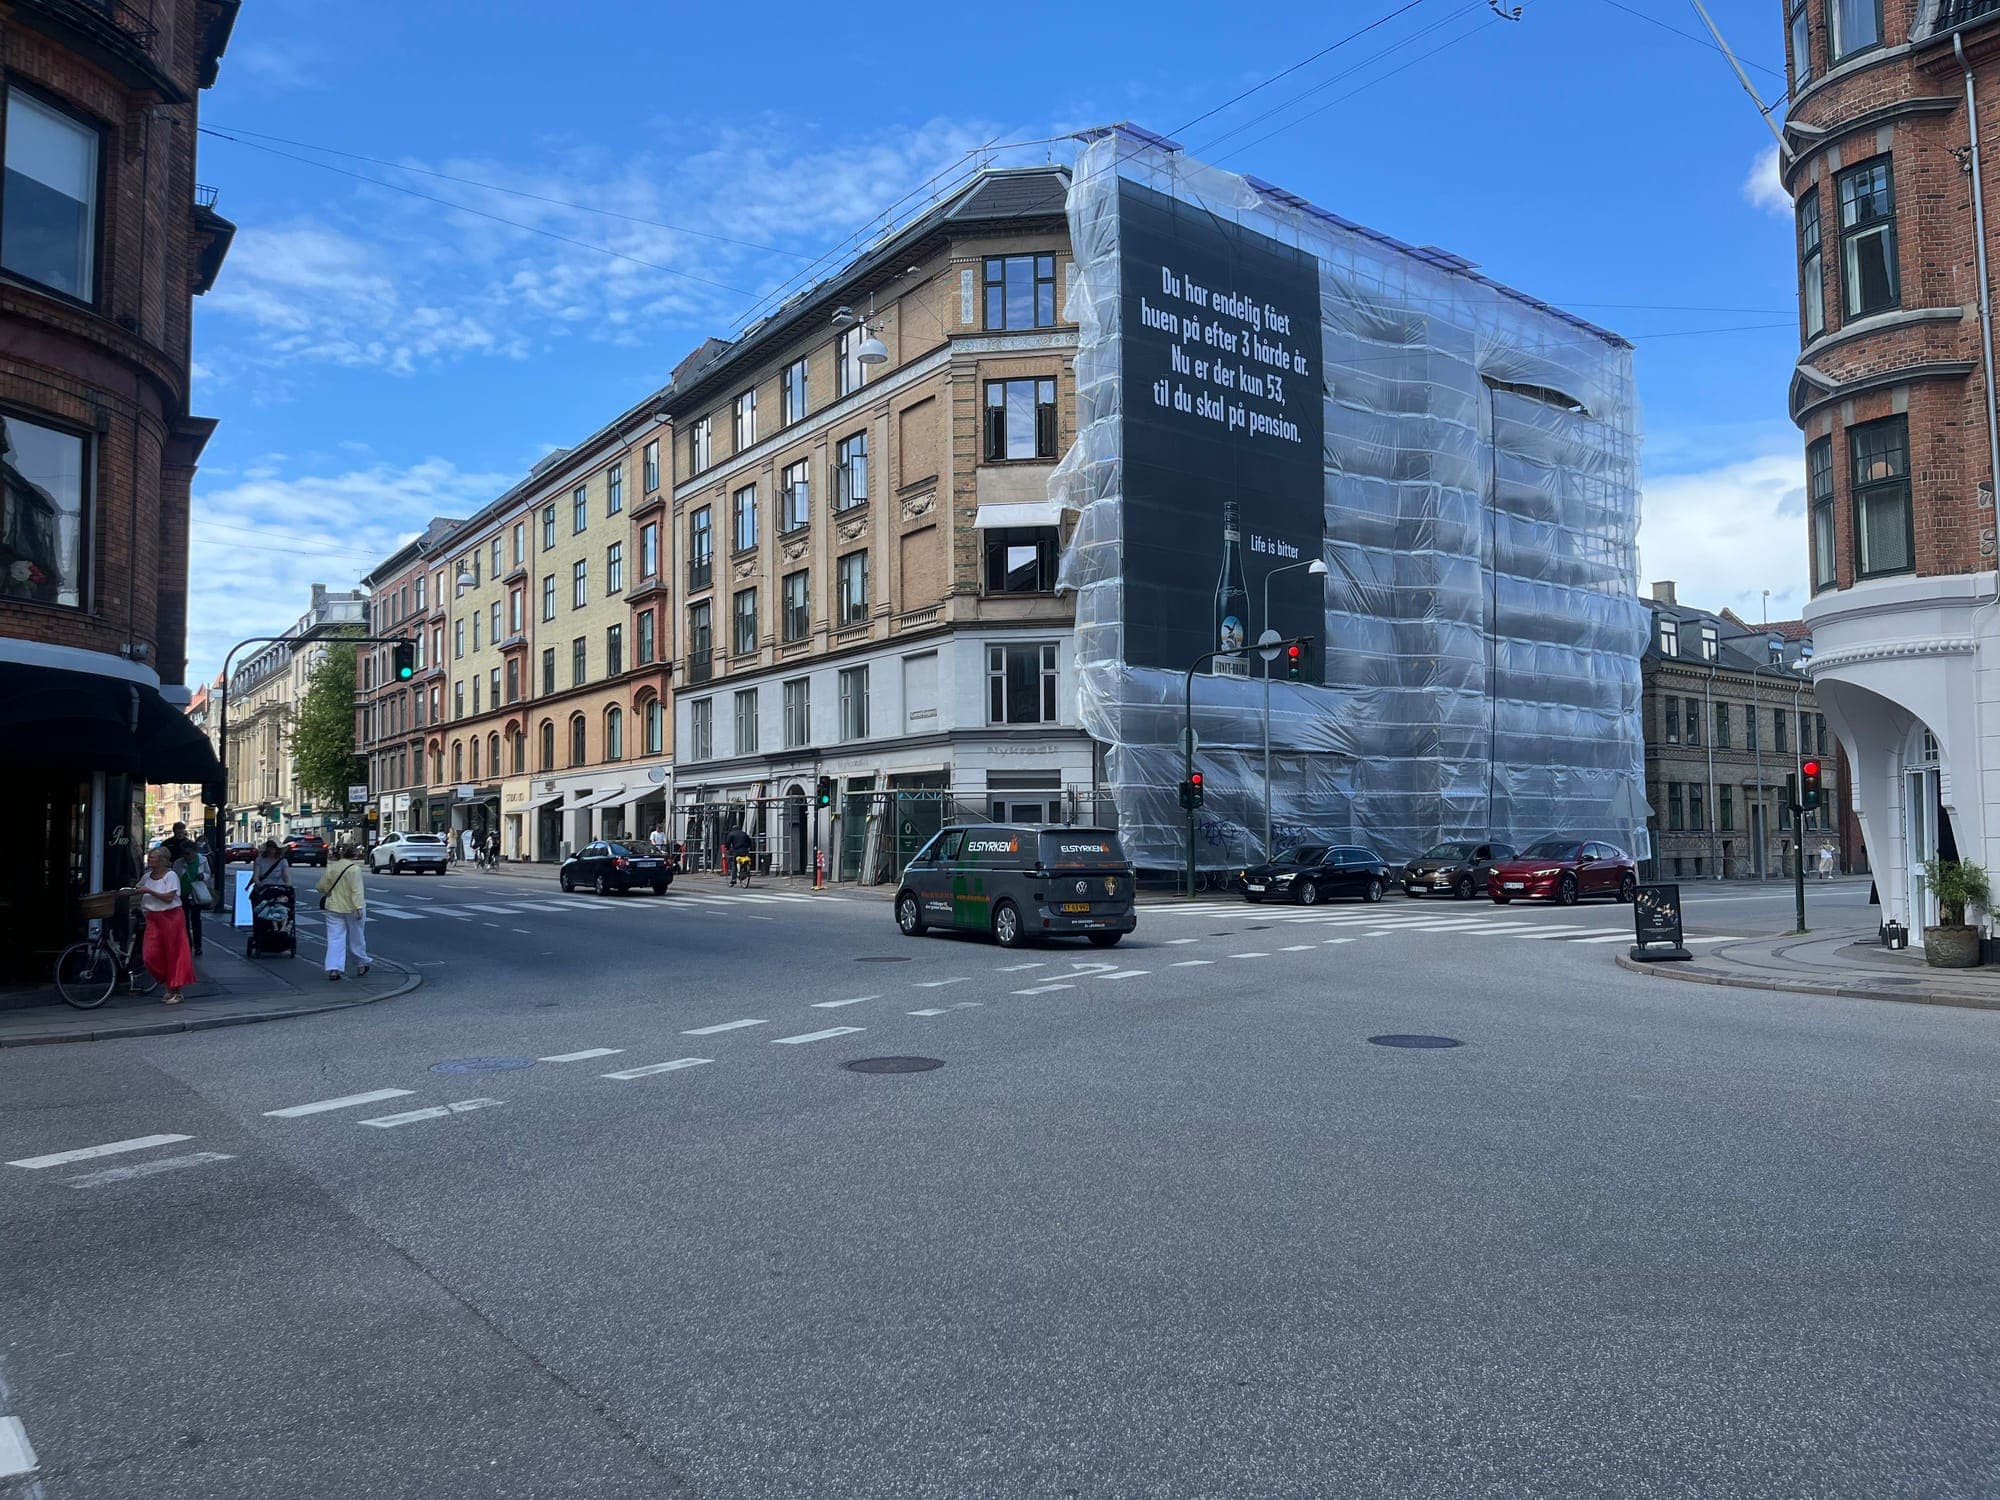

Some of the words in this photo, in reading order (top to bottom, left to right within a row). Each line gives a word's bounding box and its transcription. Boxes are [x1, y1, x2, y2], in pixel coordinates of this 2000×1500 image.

[1162, 265, 1181, 299] Du
[1184, 274, 1209, 308] har
[1212, 291, 1261, 332] endelig
[1264, 303, 1291, 336] fået
[1141, 296, 1179, 335] huen
[1182, 314, 1200, 345] på
[1204, 321, 1238, 351] efter
[1241, 330, 1250, 357] 3
[1253, 334, 1290, 370] hårde
[1293, 349, 1309, 377] år.
[1171, 343, 1190, 376] Nu
[1194, 359, 1209, 381] er
[1213, 358, 1236, 388] der
[1239, 364, 1264, 398] kun
[1266, 373, 1286, 407] 53,
[1153, 379, 1169, 408] til
[1174, 383, 1192, 414] du
[1196, 390, 1225, 423] skal
[1228, 401, 1245, 432] på
[1249, 411, 1302, 444] pension.
[1250, 534, 1266, 553] Life
[1268, 537, 1276, 555] is
[1277, 539, 1299, 560] bitter
[968, 841, 1011, 852] ELSTYRKEN
[1060, 845, 1103, 853] ELSTYRKEN
